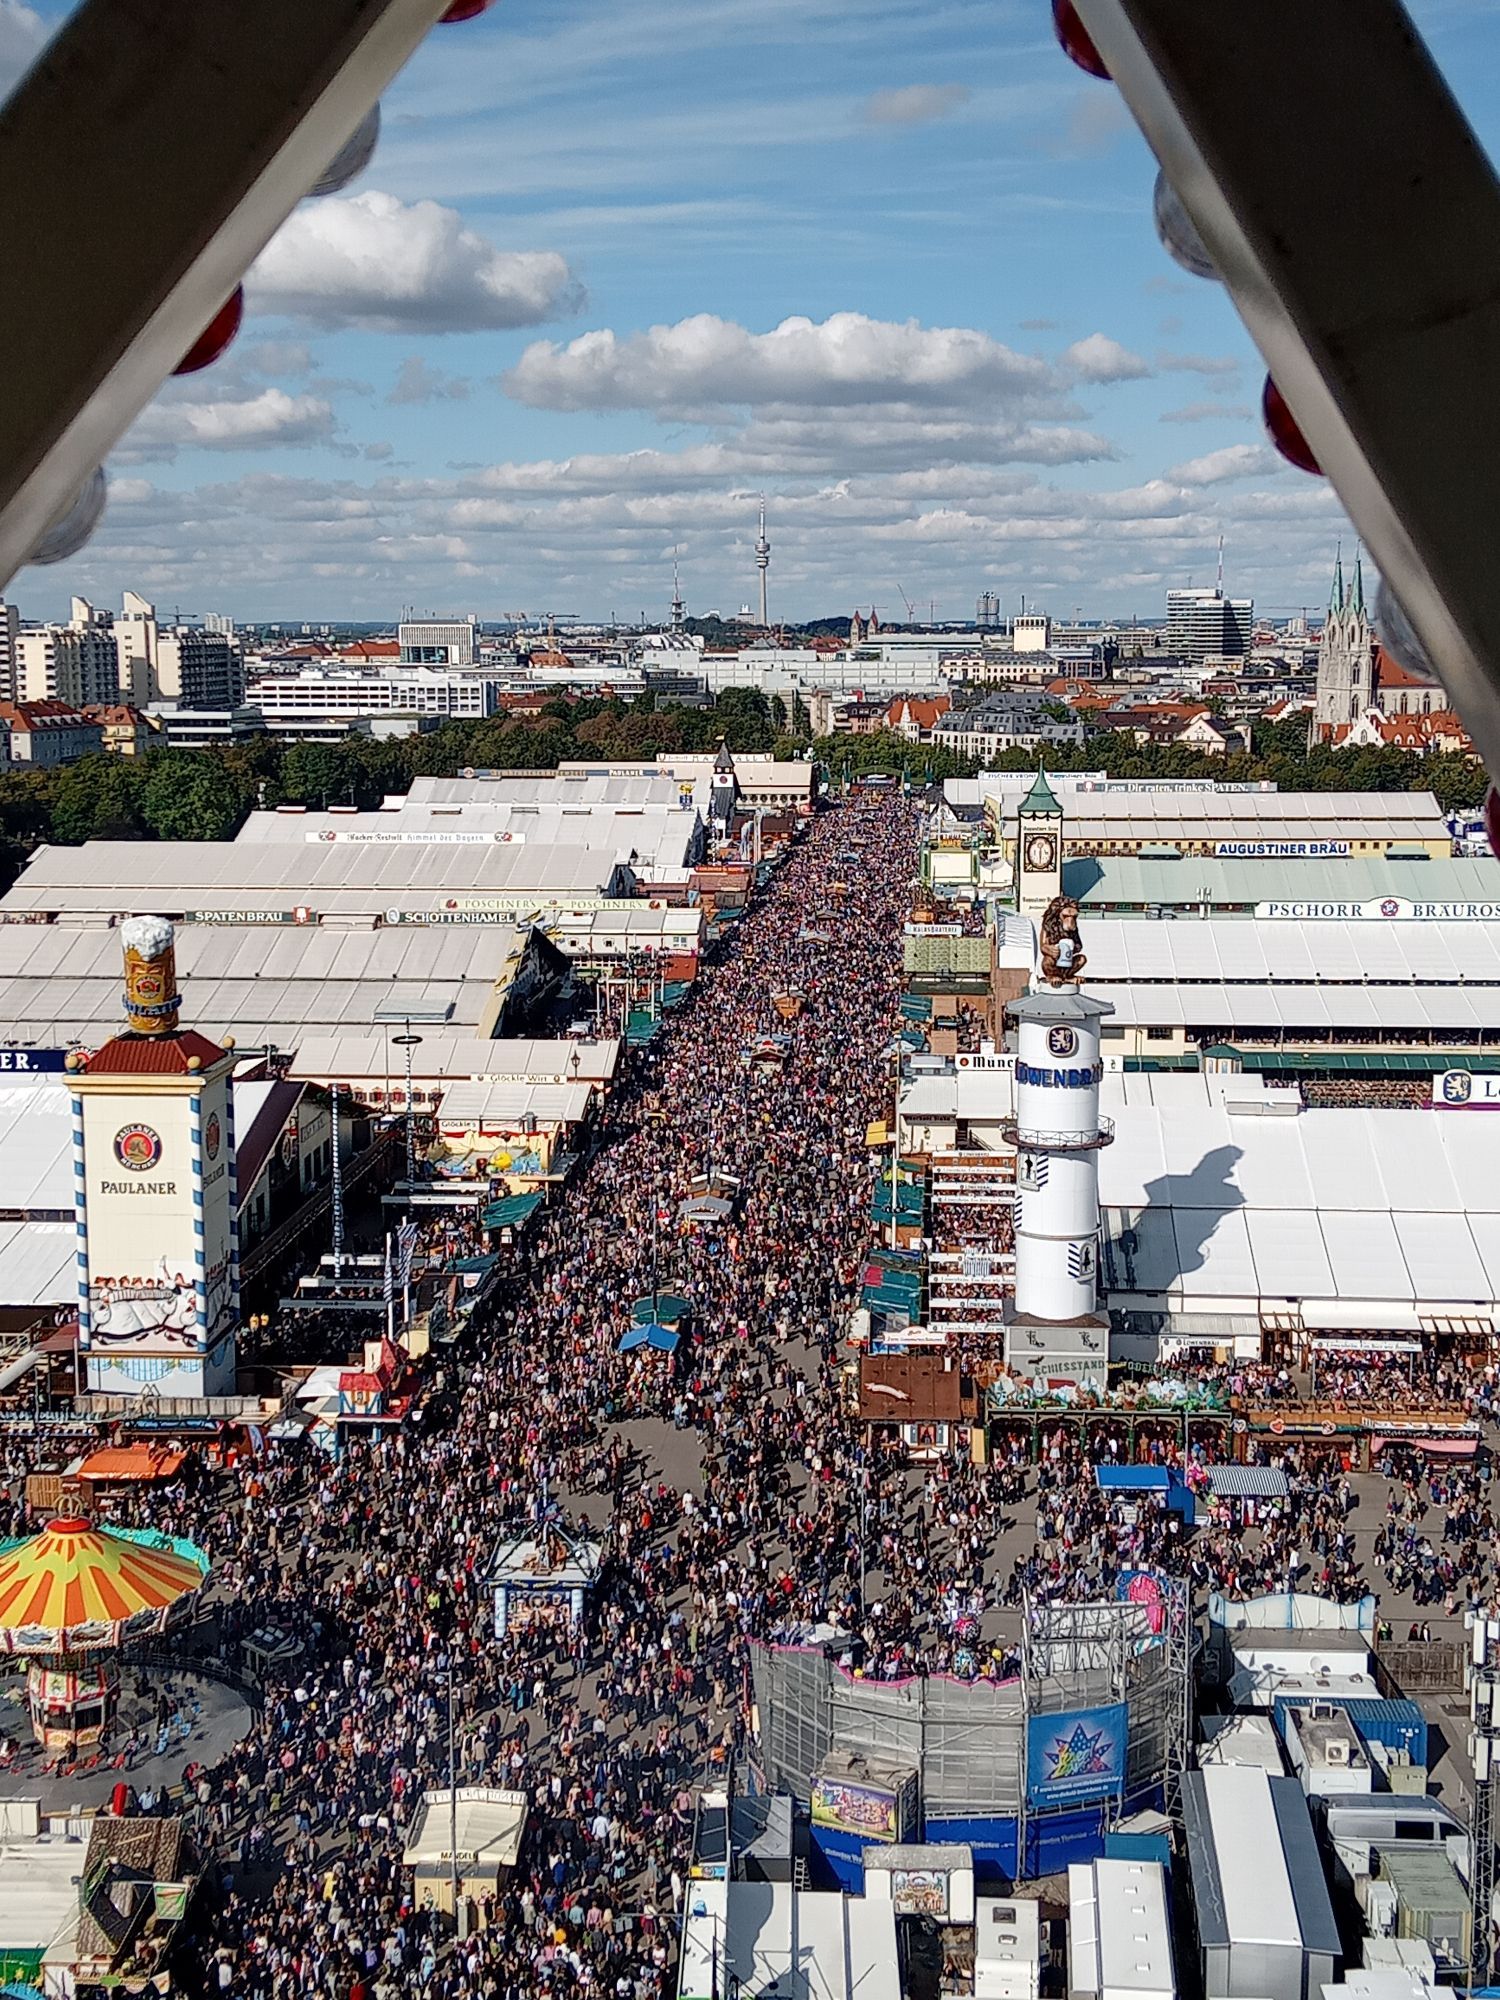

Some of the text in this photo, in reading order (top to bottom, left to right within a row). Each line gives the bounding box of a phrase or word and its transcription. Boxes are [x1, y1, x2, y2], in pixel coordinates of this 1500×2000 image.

[1104, 783, 1249, 794] Lass Dir raten, trinke SPATEN.
[1219, 841, 1347, 855] AUGUSTINER BRÄU
[464, 899, 537, 909] POSCHNER'S
[570, 900, 643, 910] POSCHNER'S
[1268, 903, 1363, 917] PSCHORR
[194, 910, 283, 922] SPATENBRÄU
[404, 911, 514, 924] SCHOTTENHAMEL
[490, 1074, 548, 1083] Glöckle Wirt
[115, 1124, 159, 1143] PAULANER
[100, 1180, 177, 1195] PAULANER
[1034, 1359, 1105, 1376] SCHIESSTAND
